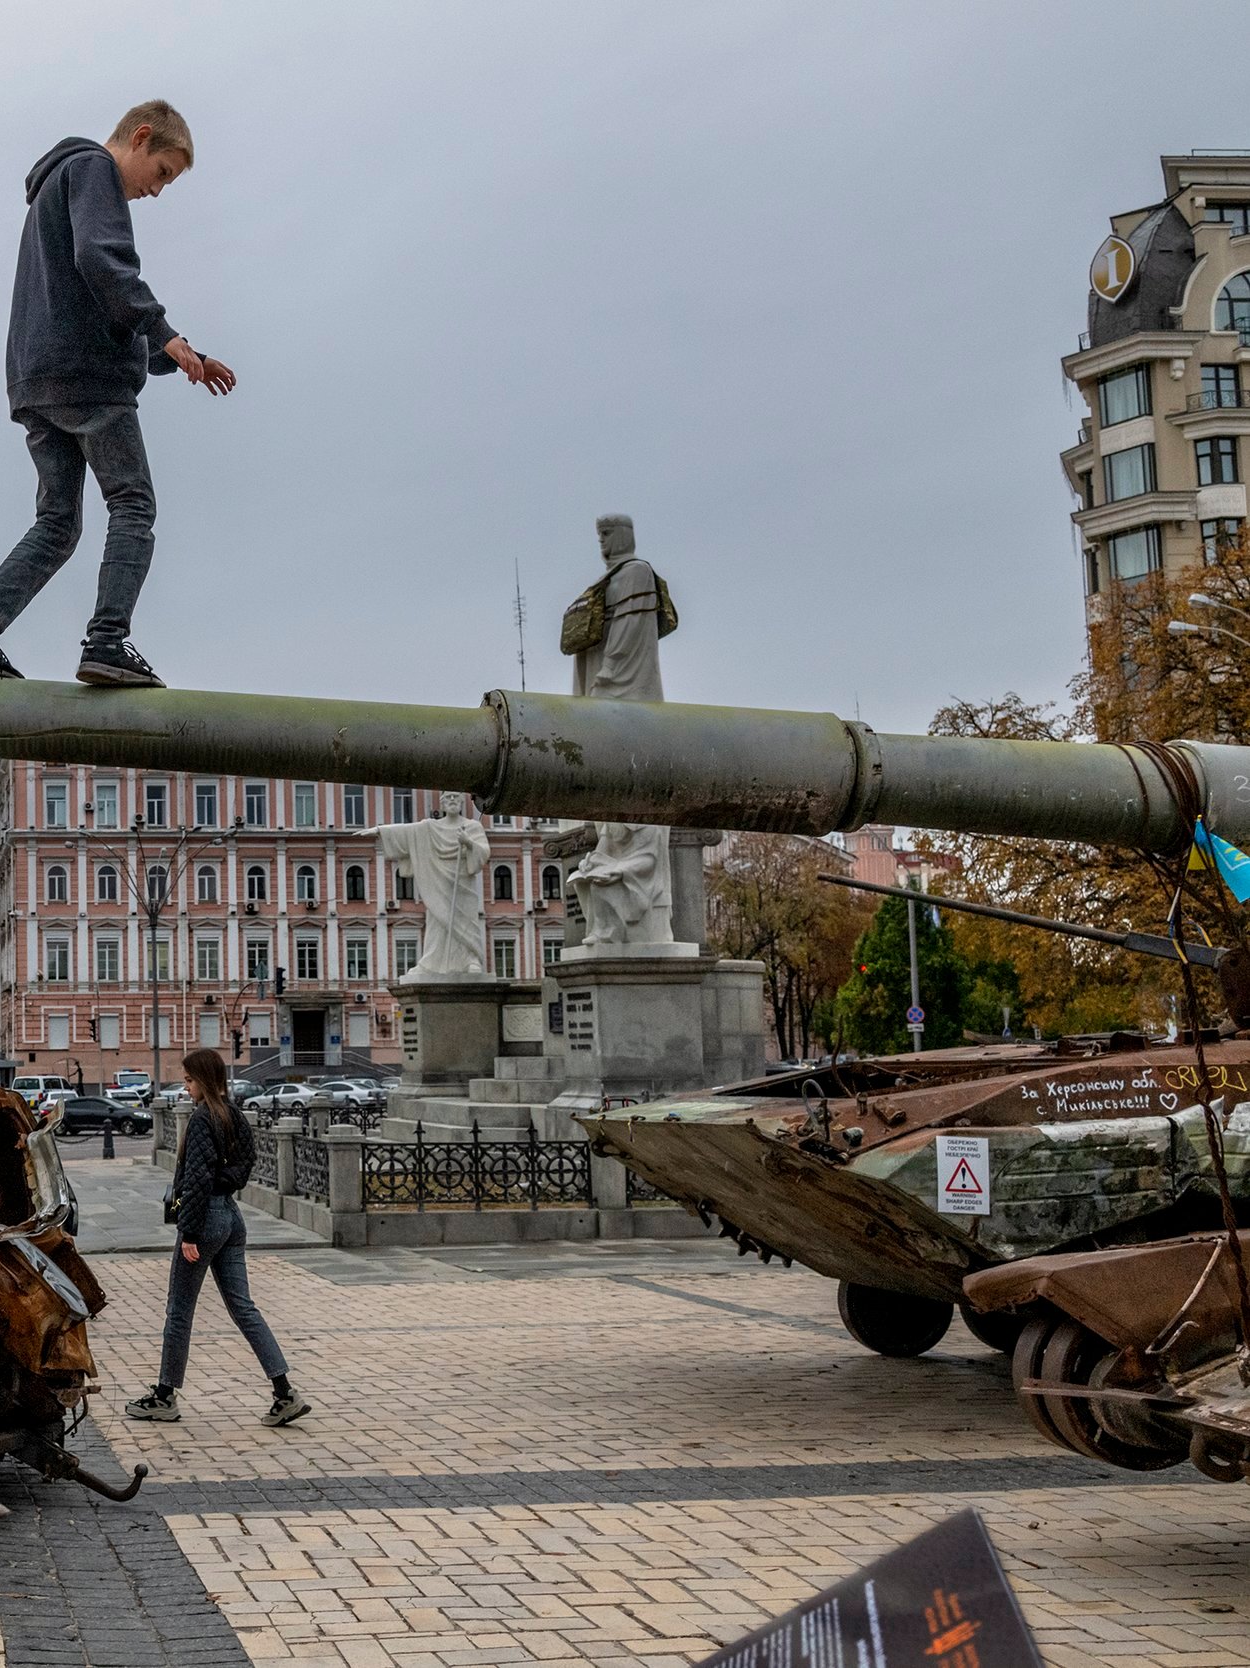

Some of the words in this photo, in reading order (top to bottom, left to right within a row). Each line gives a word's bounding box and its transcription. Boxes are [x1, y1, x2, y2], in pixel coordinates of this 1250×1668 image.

[1020, 1085, 1039, 1099] За
[1046, 1079, 1124, 1098] Херсонську
[1131, 1068, 1161, 1089] обл.
[1036, 1106, 1048, 1115] с.
[1056, 1094, 1150, 1112] Микільське!!!
